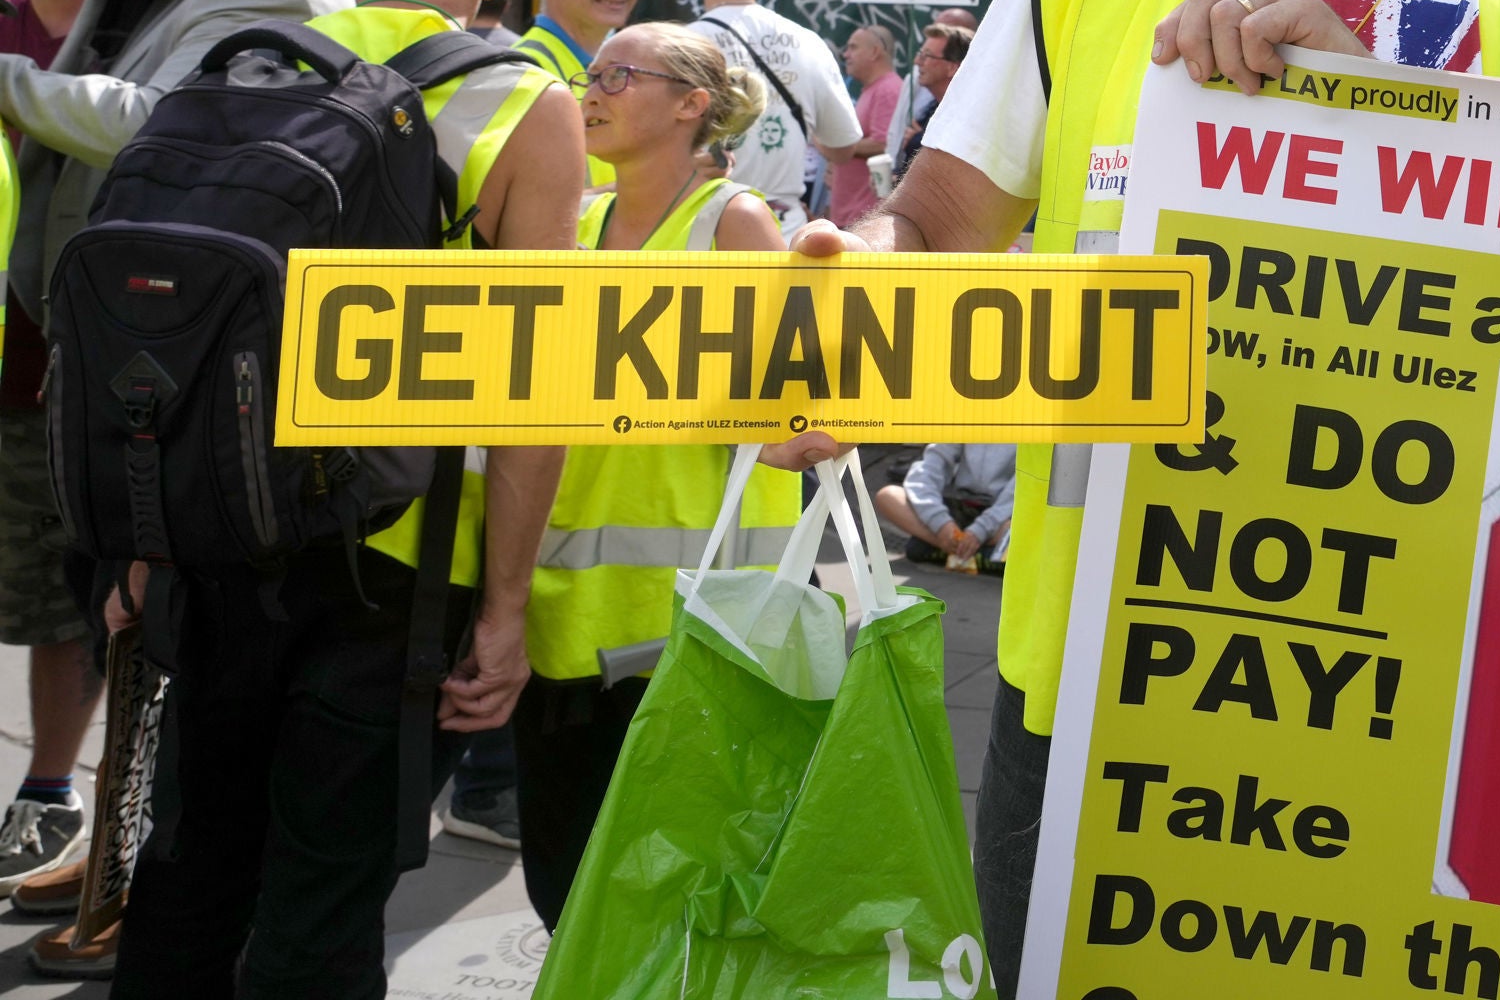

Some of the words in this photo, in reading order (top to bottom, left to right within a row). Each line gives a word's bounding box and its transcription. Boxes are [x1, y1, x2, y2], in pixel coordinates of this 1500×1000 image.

[1350, 85, 1458, 121] proudly
[1467, 96, 1491, 120] in
[1088, 149, 1130, 176] Taylo
[1196, 121, 1344, 205] WE
[1176, 237, 1457, 338] DRIVE
[313, 284, 565, 401] GET
[593, 285, 916, 401] KHAN
[949, 287, 1180, 401] OUT
[1206, 326, 1267, 369] ow,
[1281, 338, 1315, 369] in
[1327, 346, 1380, 378] All
[1393, 354, 1478, 392] Ulez
[633, 419, 666, 429] Action
[668, 419, 704, 430] Against
[707, 420, 731, 429] ULEZ
[733, 419, 781, 429] Extension
[810, 419, 885, 429] @AntiExtension
[1154, 389, 1240, 476] &
[1286, 404, 1456, 505] DO
[1135, 503, 1398, 615] NOT
[1119, 622, 1403, 741] PAY!
[1102, 761, 1351, 859] Take
[1087, 873, 1367, 978] Down
